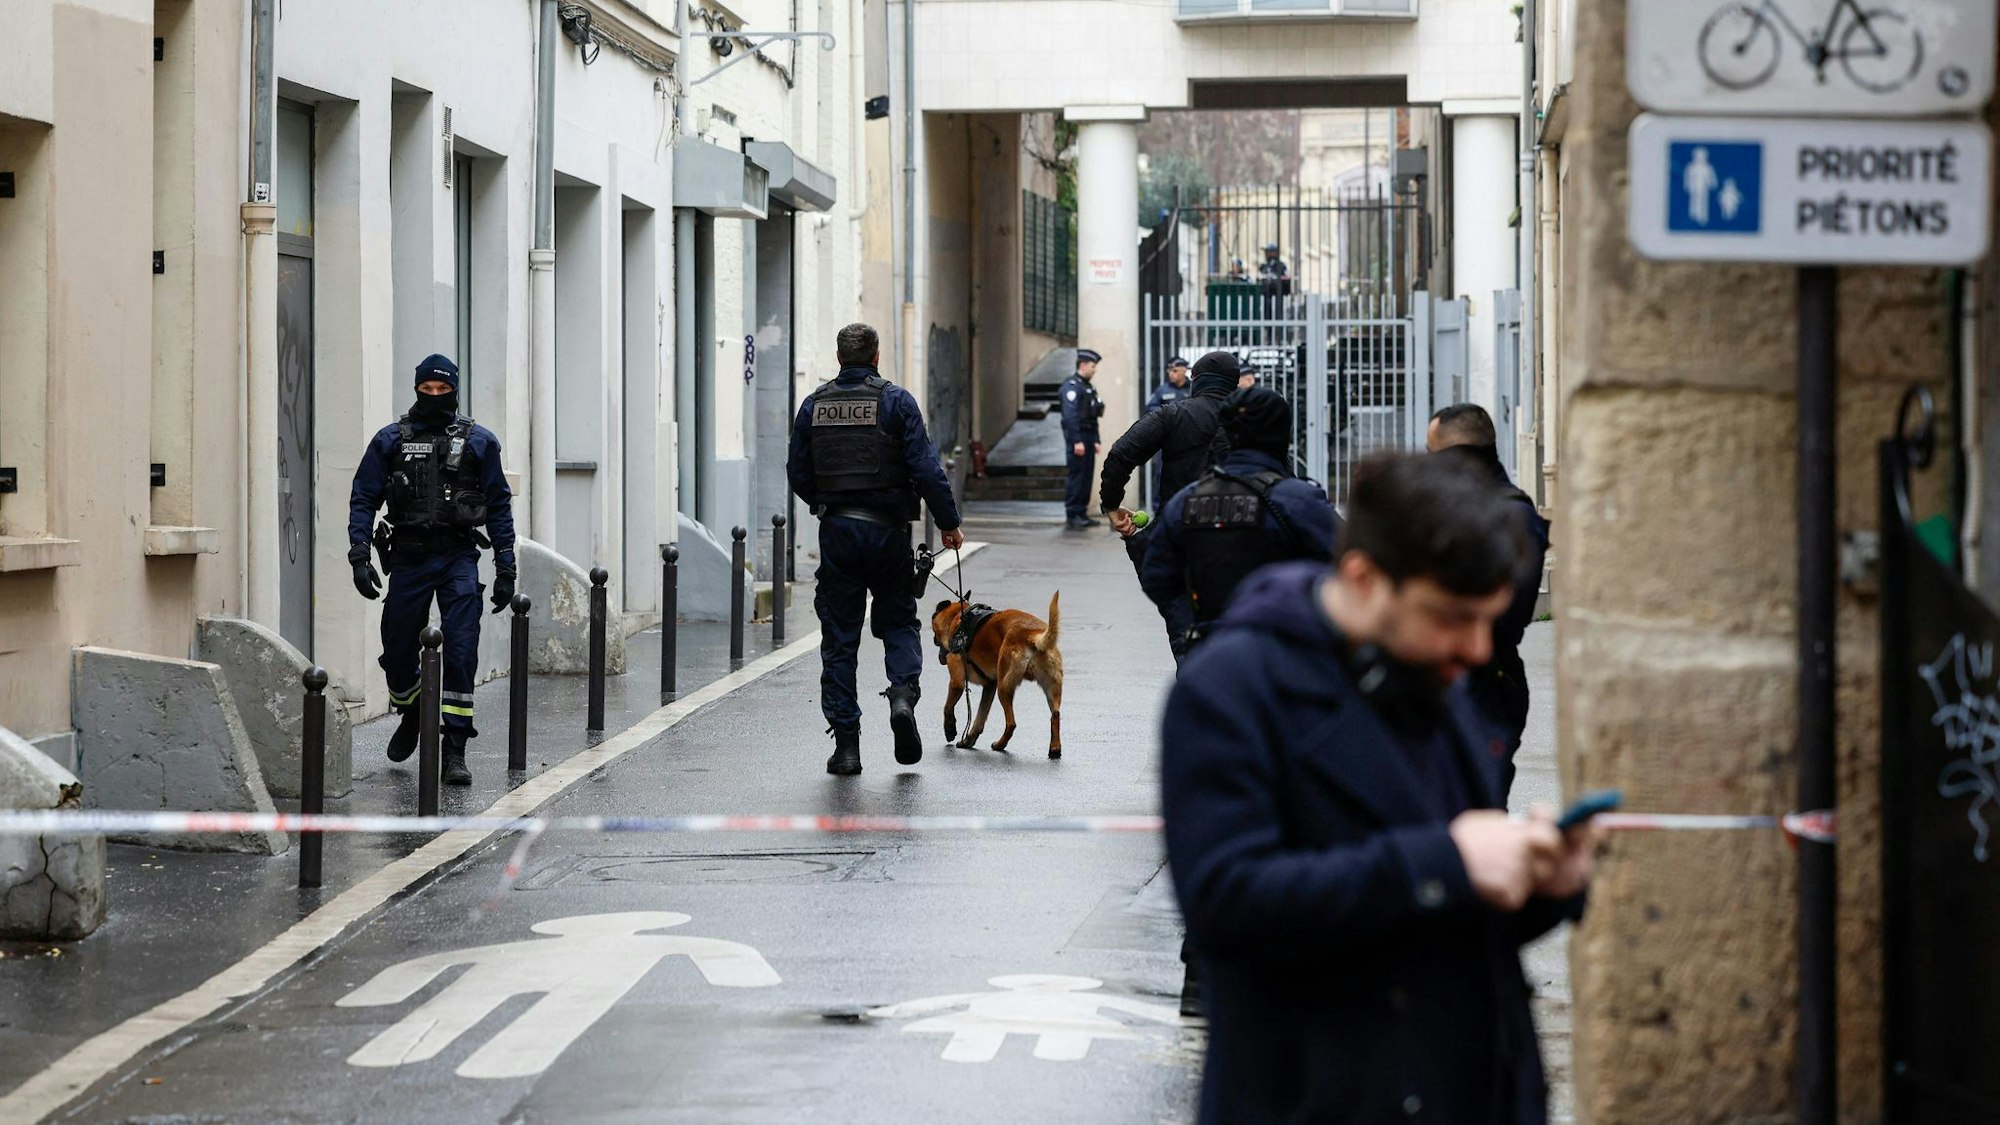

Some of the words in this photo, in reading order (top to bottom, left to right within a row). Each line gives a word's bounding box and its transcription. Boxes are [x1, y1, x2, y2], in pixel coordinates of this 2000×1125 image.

[1797, 140, 1958, 183] PRIORITÉ
[1797, 191, 1949, 235] PIÉTONS
[817, 406, 872, 420] POLICE
[402, 444, 432, 452] POLICE
[1184, 495, 1259, 524] POLICE
